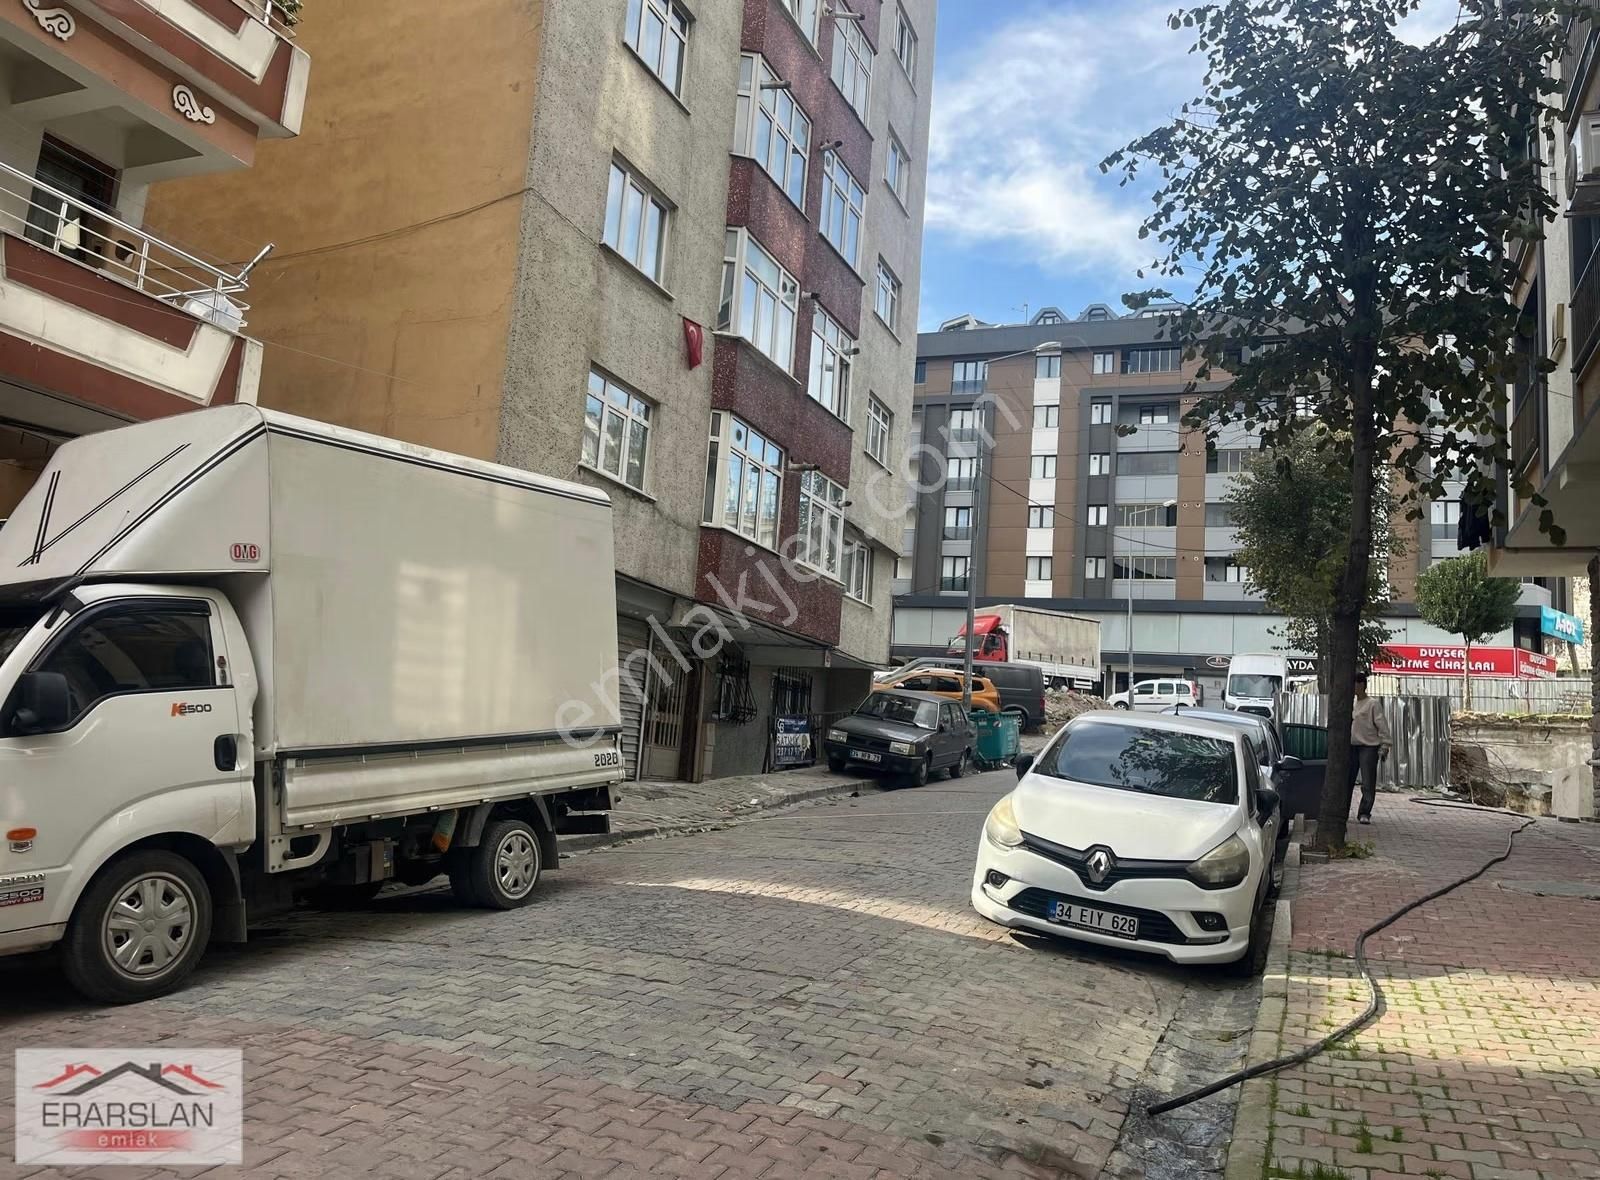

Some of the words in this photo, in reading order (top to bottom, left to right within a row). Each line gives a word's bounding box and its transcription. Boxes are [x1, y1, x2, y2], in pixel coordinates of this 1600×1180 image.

[233, 544, 257, 559] OMG
[1420, 648, 1465, 659] DUYSER
[1057, 903, 1072, 920] 34
[1080, 908, 1104, 927] EIY
[1111, 915, 1137, 933] 628
